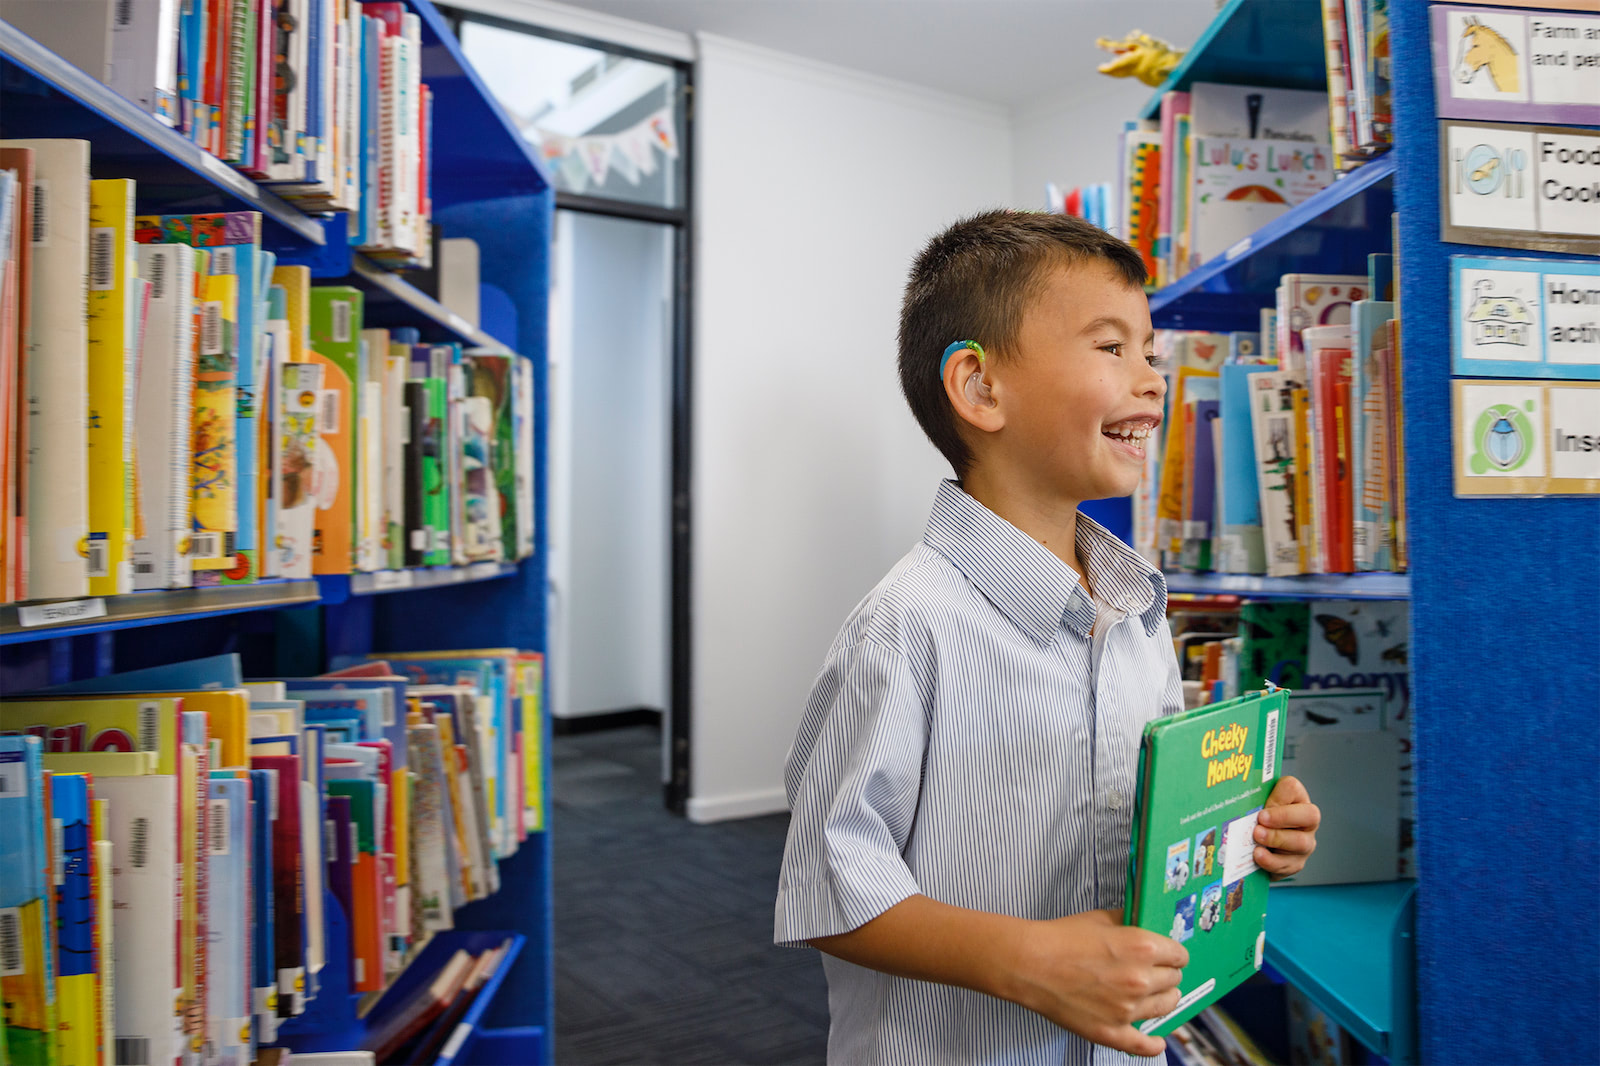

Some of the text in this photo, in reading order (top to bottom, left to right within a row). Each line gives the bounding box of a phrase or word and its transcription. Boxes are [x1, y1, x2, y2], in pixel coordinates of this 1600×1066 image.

[1531, 21, 1580, 39] Farm
[1532, 50, 1569, 66] and
[1198, 139, 1327, 173] Lulu's Lunch
[1541, 141, 1600, 165] Food
[1555, 428, 1600, 452] Ins
[1200, 722, 1249, 759] Cheeky
[1206, 752, 1253, 789] Monkey
